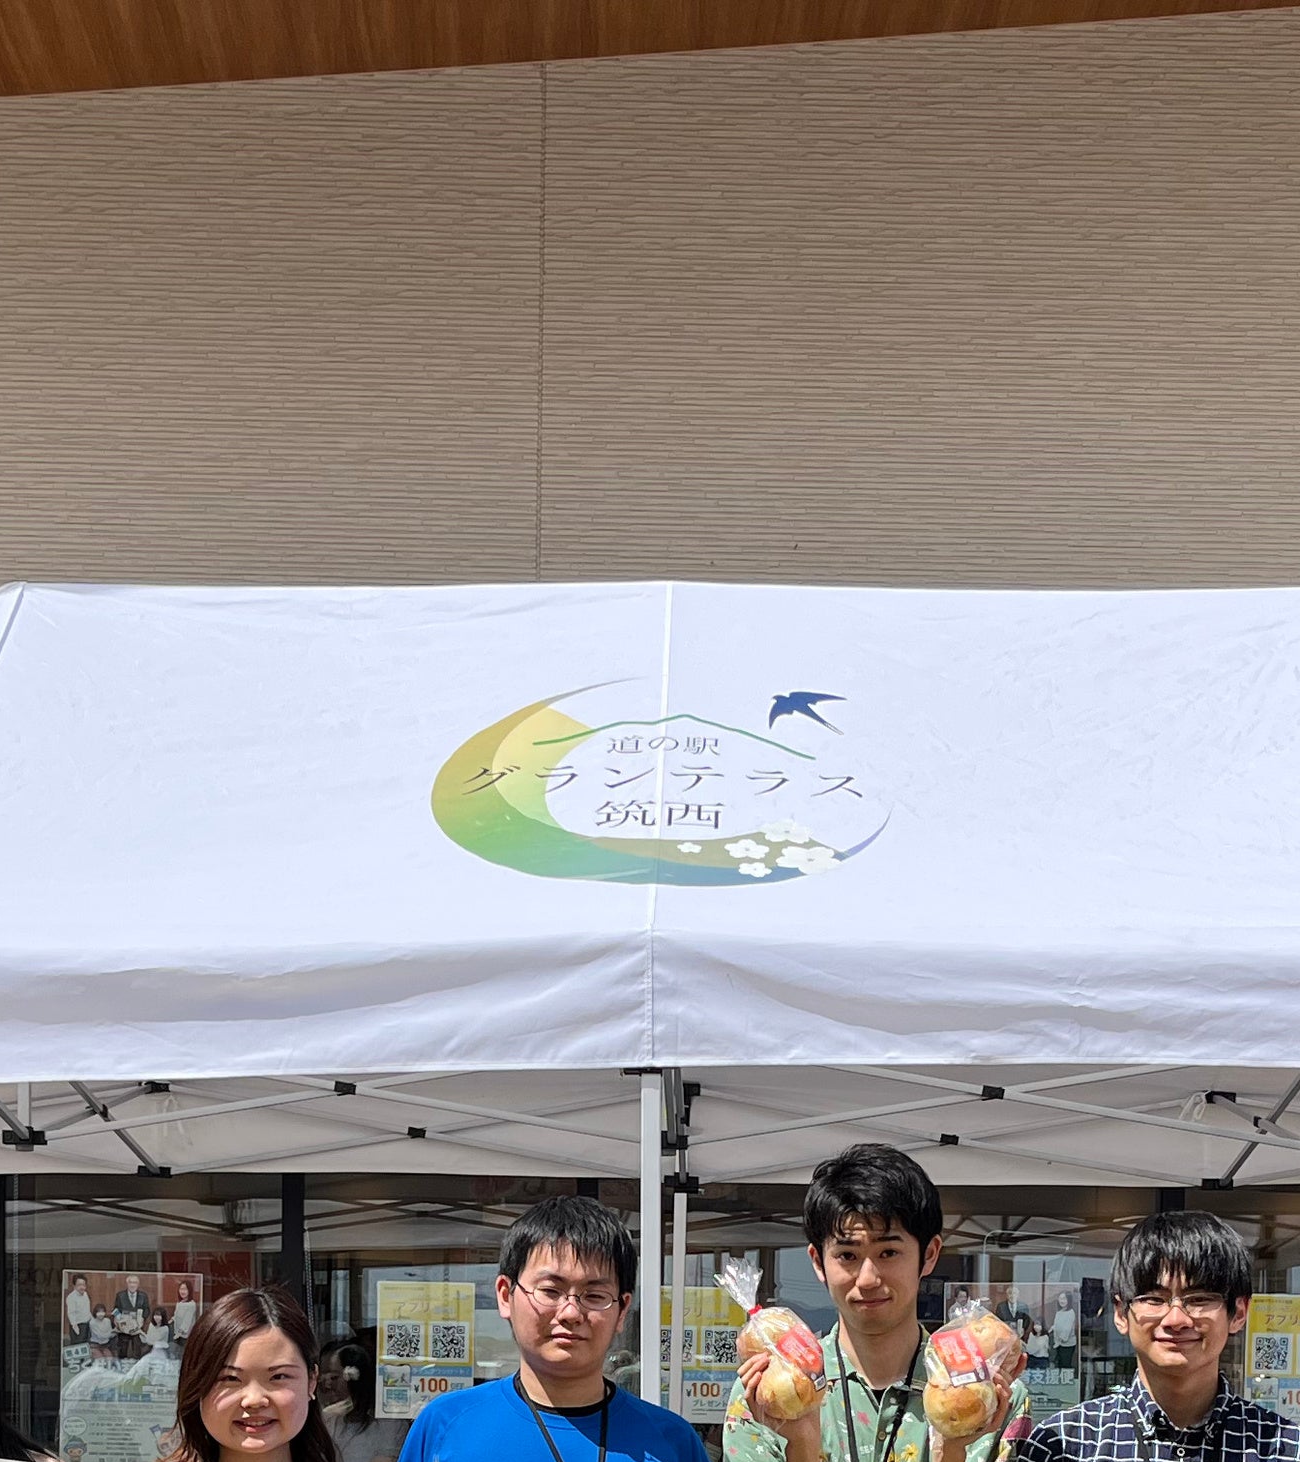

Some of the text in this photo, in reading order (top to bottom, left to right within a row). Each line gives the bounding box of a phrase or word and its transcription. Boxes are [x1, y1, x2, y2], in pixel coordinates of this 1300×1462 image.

[607, 735, 721, 756] 道の駅
[461, 765, 863, 798] グランテラス
[594, 799, 726, 830] 筑西
[1265, 1314, 1299, 1326] アプリ
[413, 1377, 448, 1394] ¥100
[686, 1382, 720, 1398] ¥100
